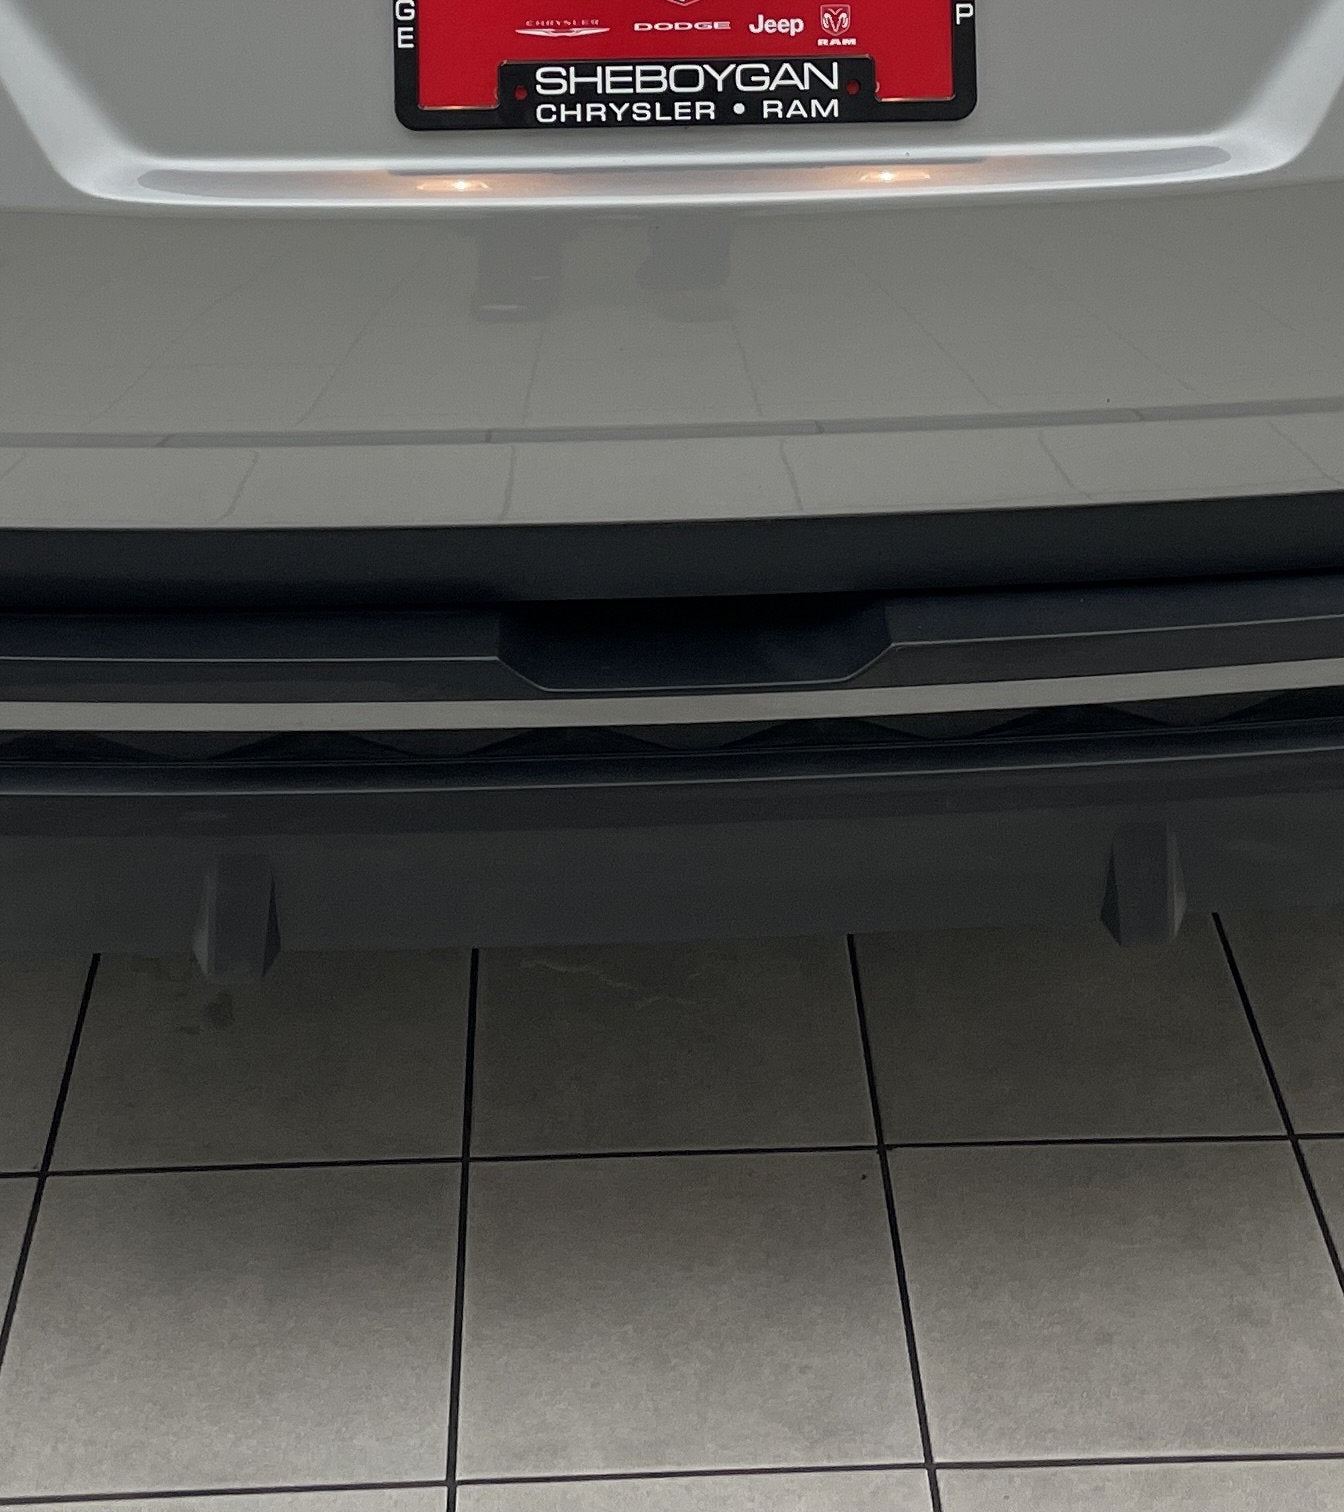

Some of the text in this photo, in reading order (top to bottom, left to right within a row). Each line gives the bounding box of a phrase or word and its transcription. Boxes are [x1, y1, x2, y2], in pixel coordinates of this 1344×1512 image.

[633, 21, 731, 32] DODGE
[748, 14, 805, 37] Jeep
[817, 38, 857, 47] RAM
[535, 61, 840, 96] SHEBOYGAN
[535, 99, 840, 124] CHRYSLER RAM
